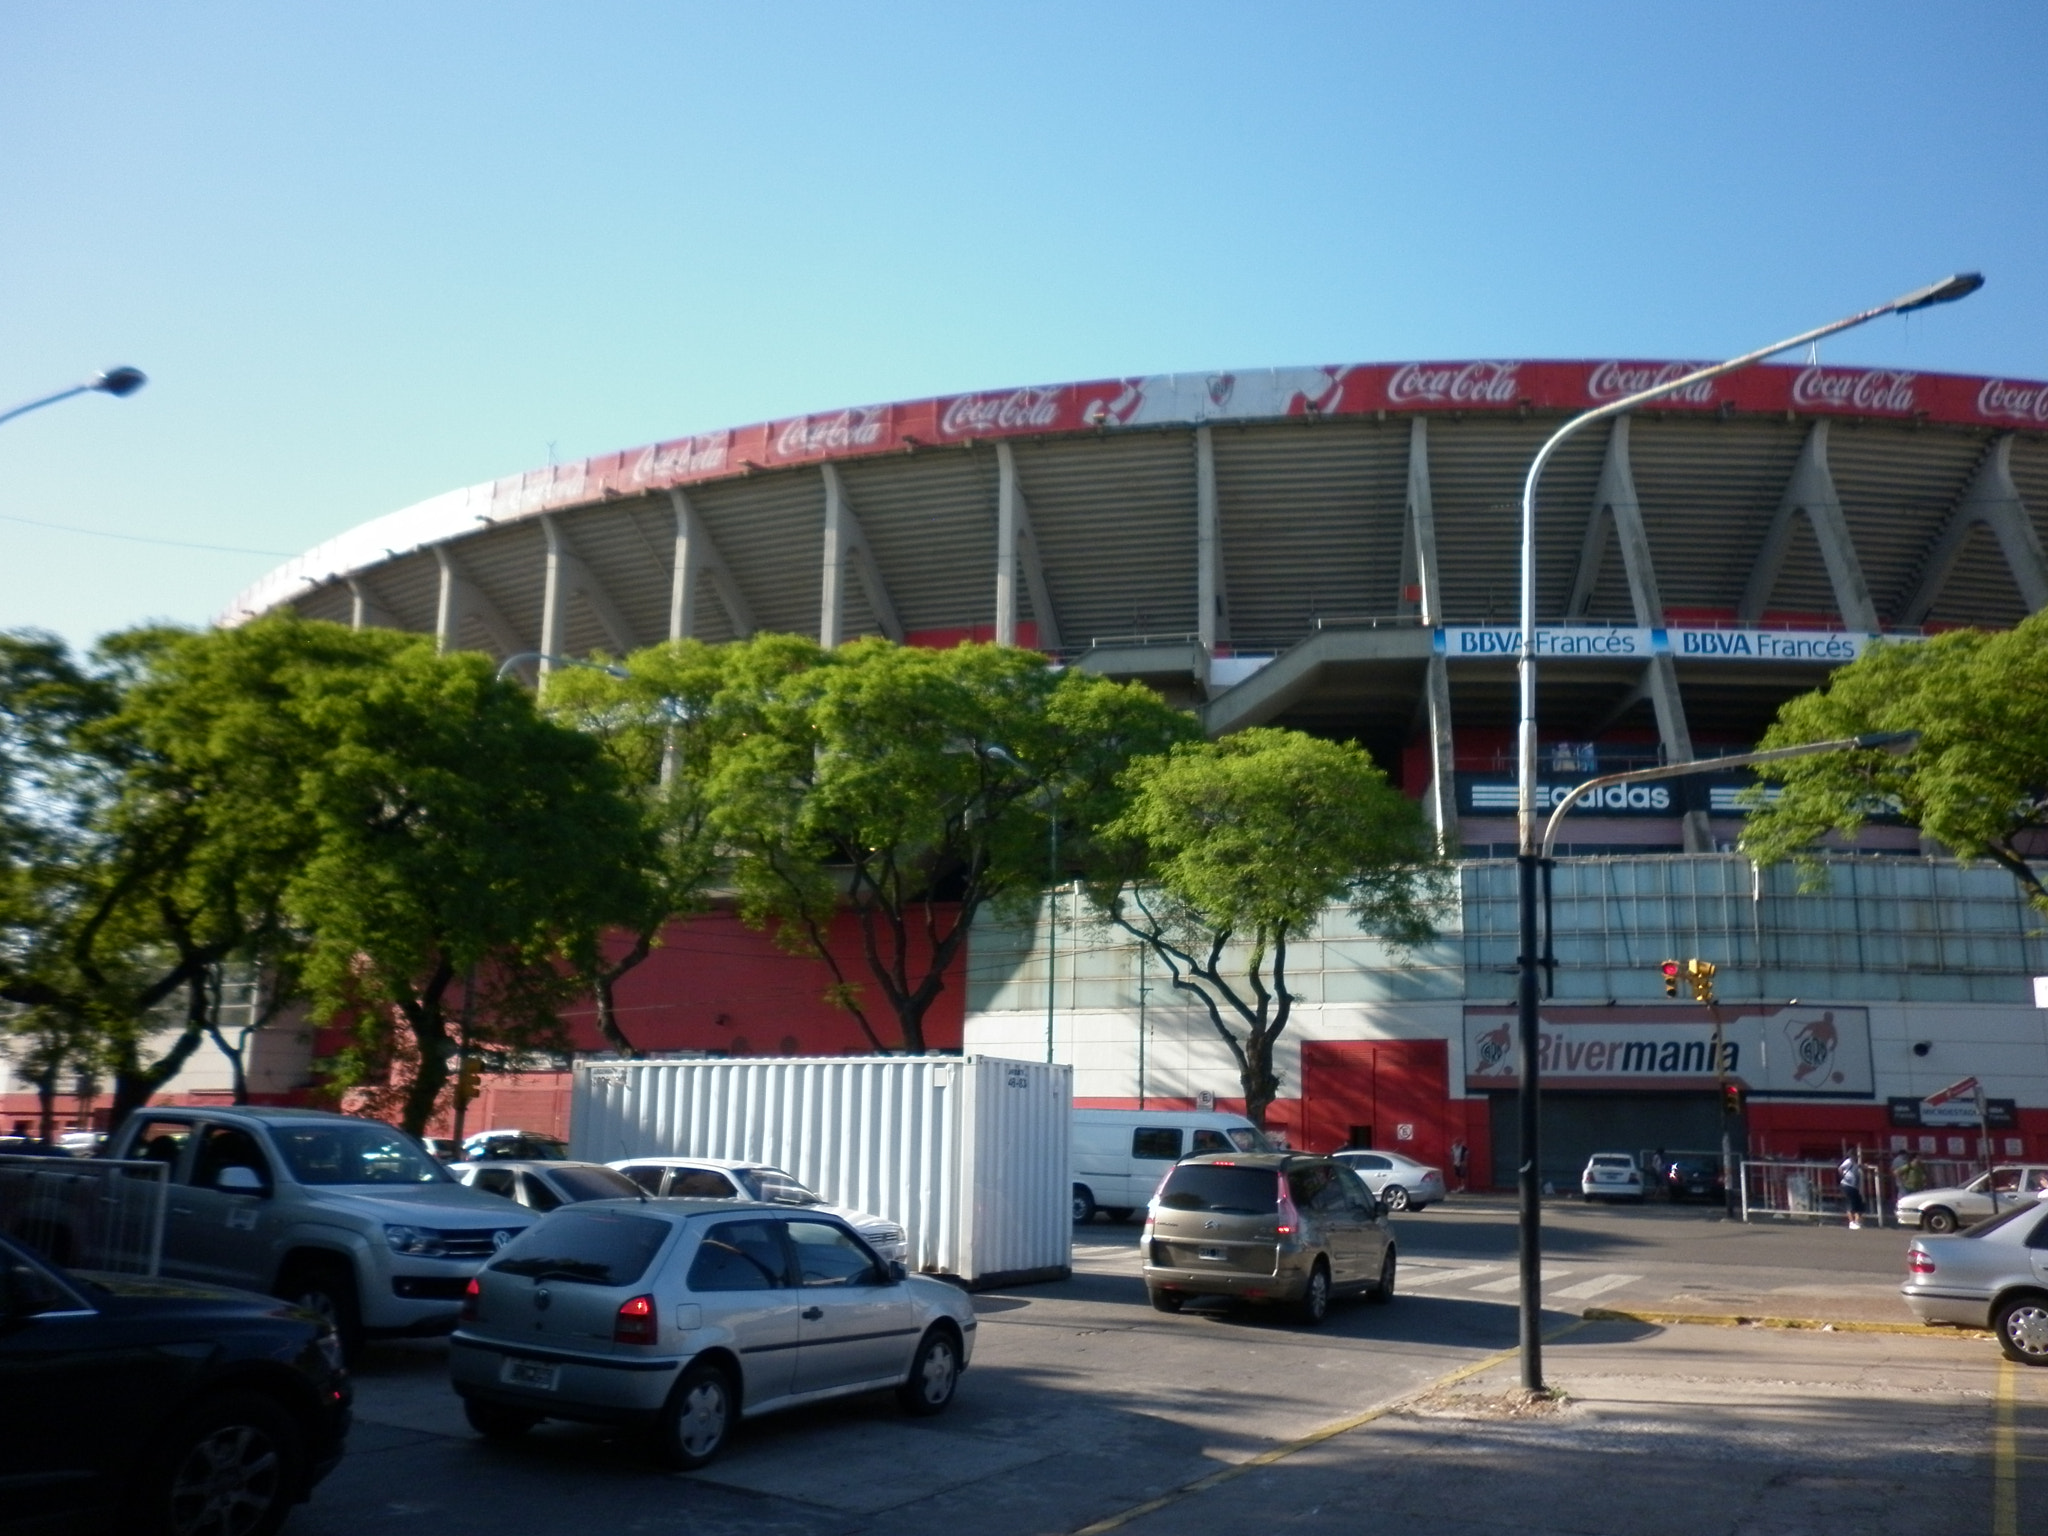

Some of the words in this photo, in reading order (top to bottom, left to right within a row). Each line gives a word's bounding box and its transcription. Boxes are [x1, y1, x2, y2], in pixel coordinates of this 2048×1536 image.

[1461, 631, 1522, 653] BBVA
[1536, 628, 1636, 654] Francés
[1683, 631, 1751, 655] BBVA
[1757, 634, 1855, 658] Francés
